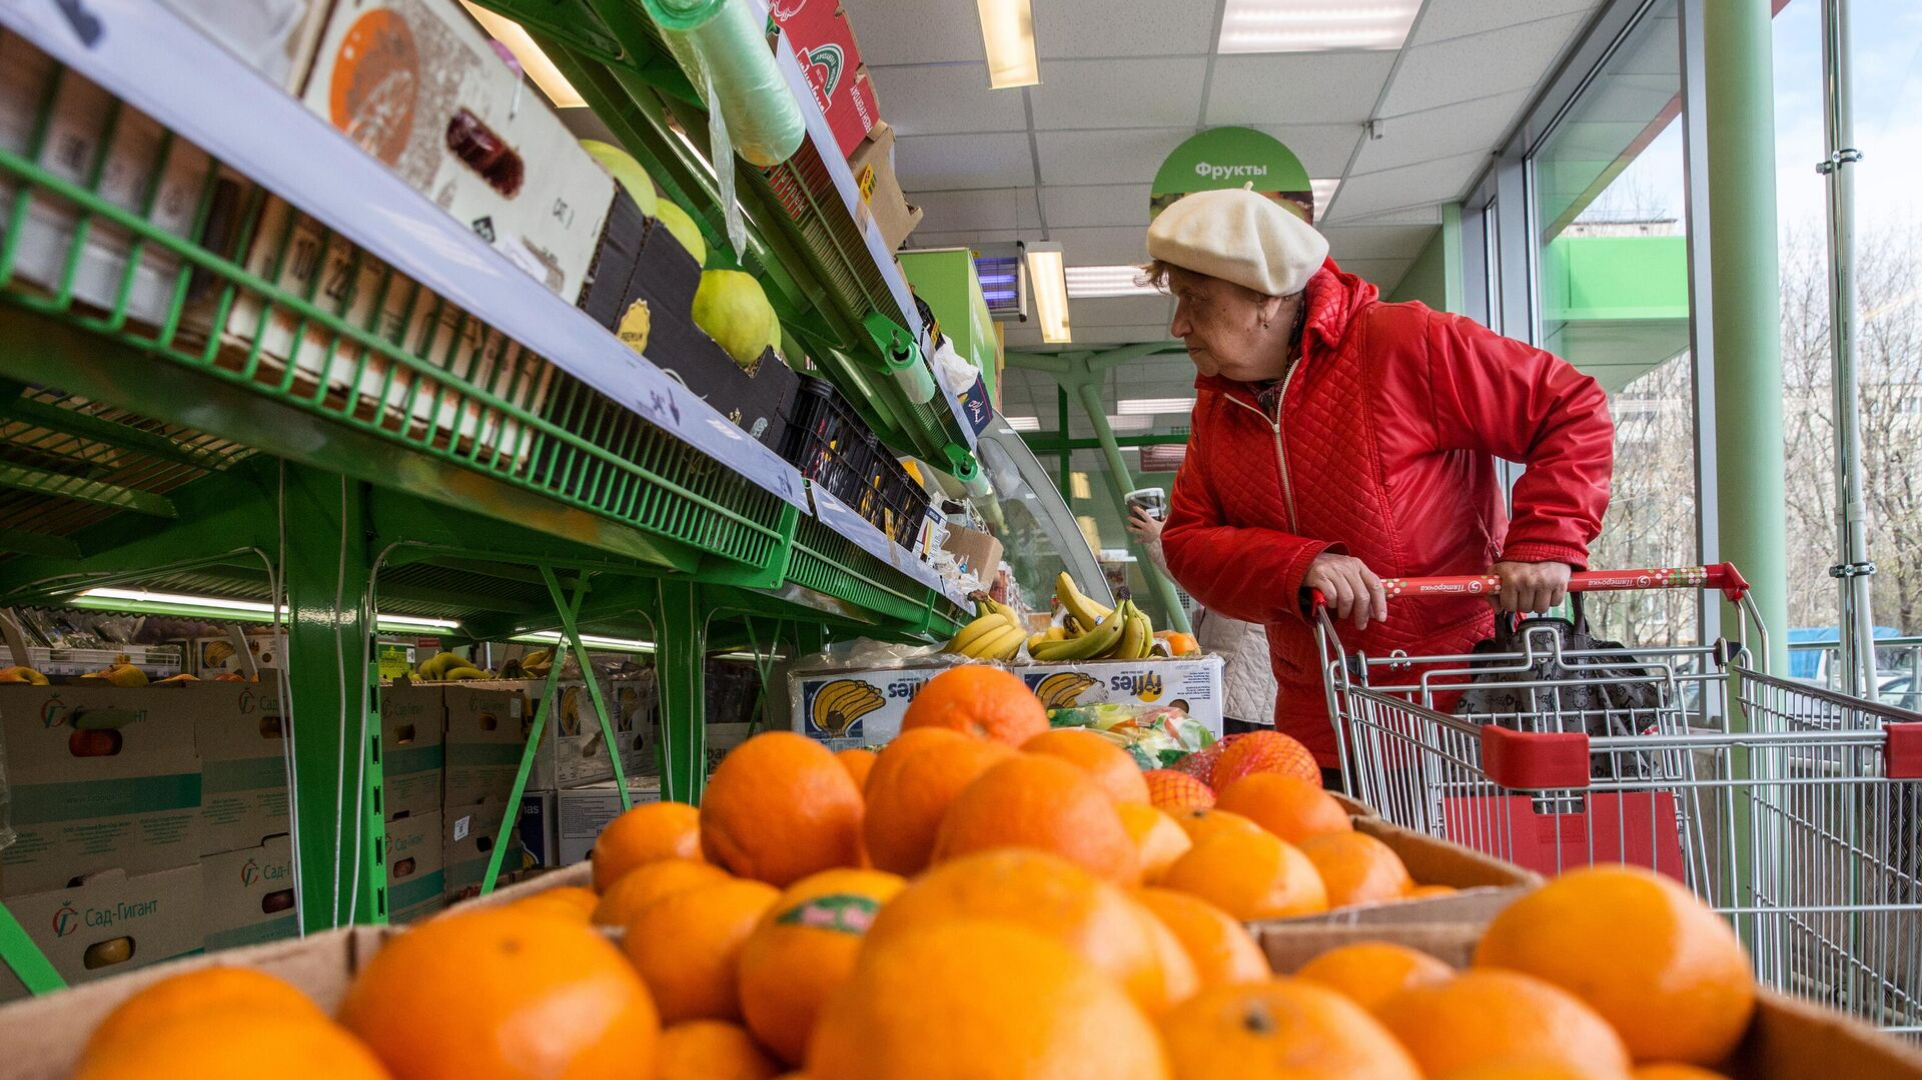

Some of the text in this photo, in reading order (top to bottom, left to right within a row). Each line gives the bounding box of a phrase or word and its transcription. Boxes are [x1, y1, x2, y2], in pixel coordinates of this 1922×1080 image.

[850, 85, 867, 117] EVERYDAY
[1195, 162, 1267, 180] Фрукты
[1420, 583, 1466, 592] Пятерочка
[1588, 578, 1635, 588] Пятерочка
[1111, 670, 1161, 696] fyffes
[85, 899, 158, 928] Сад-Гигант
